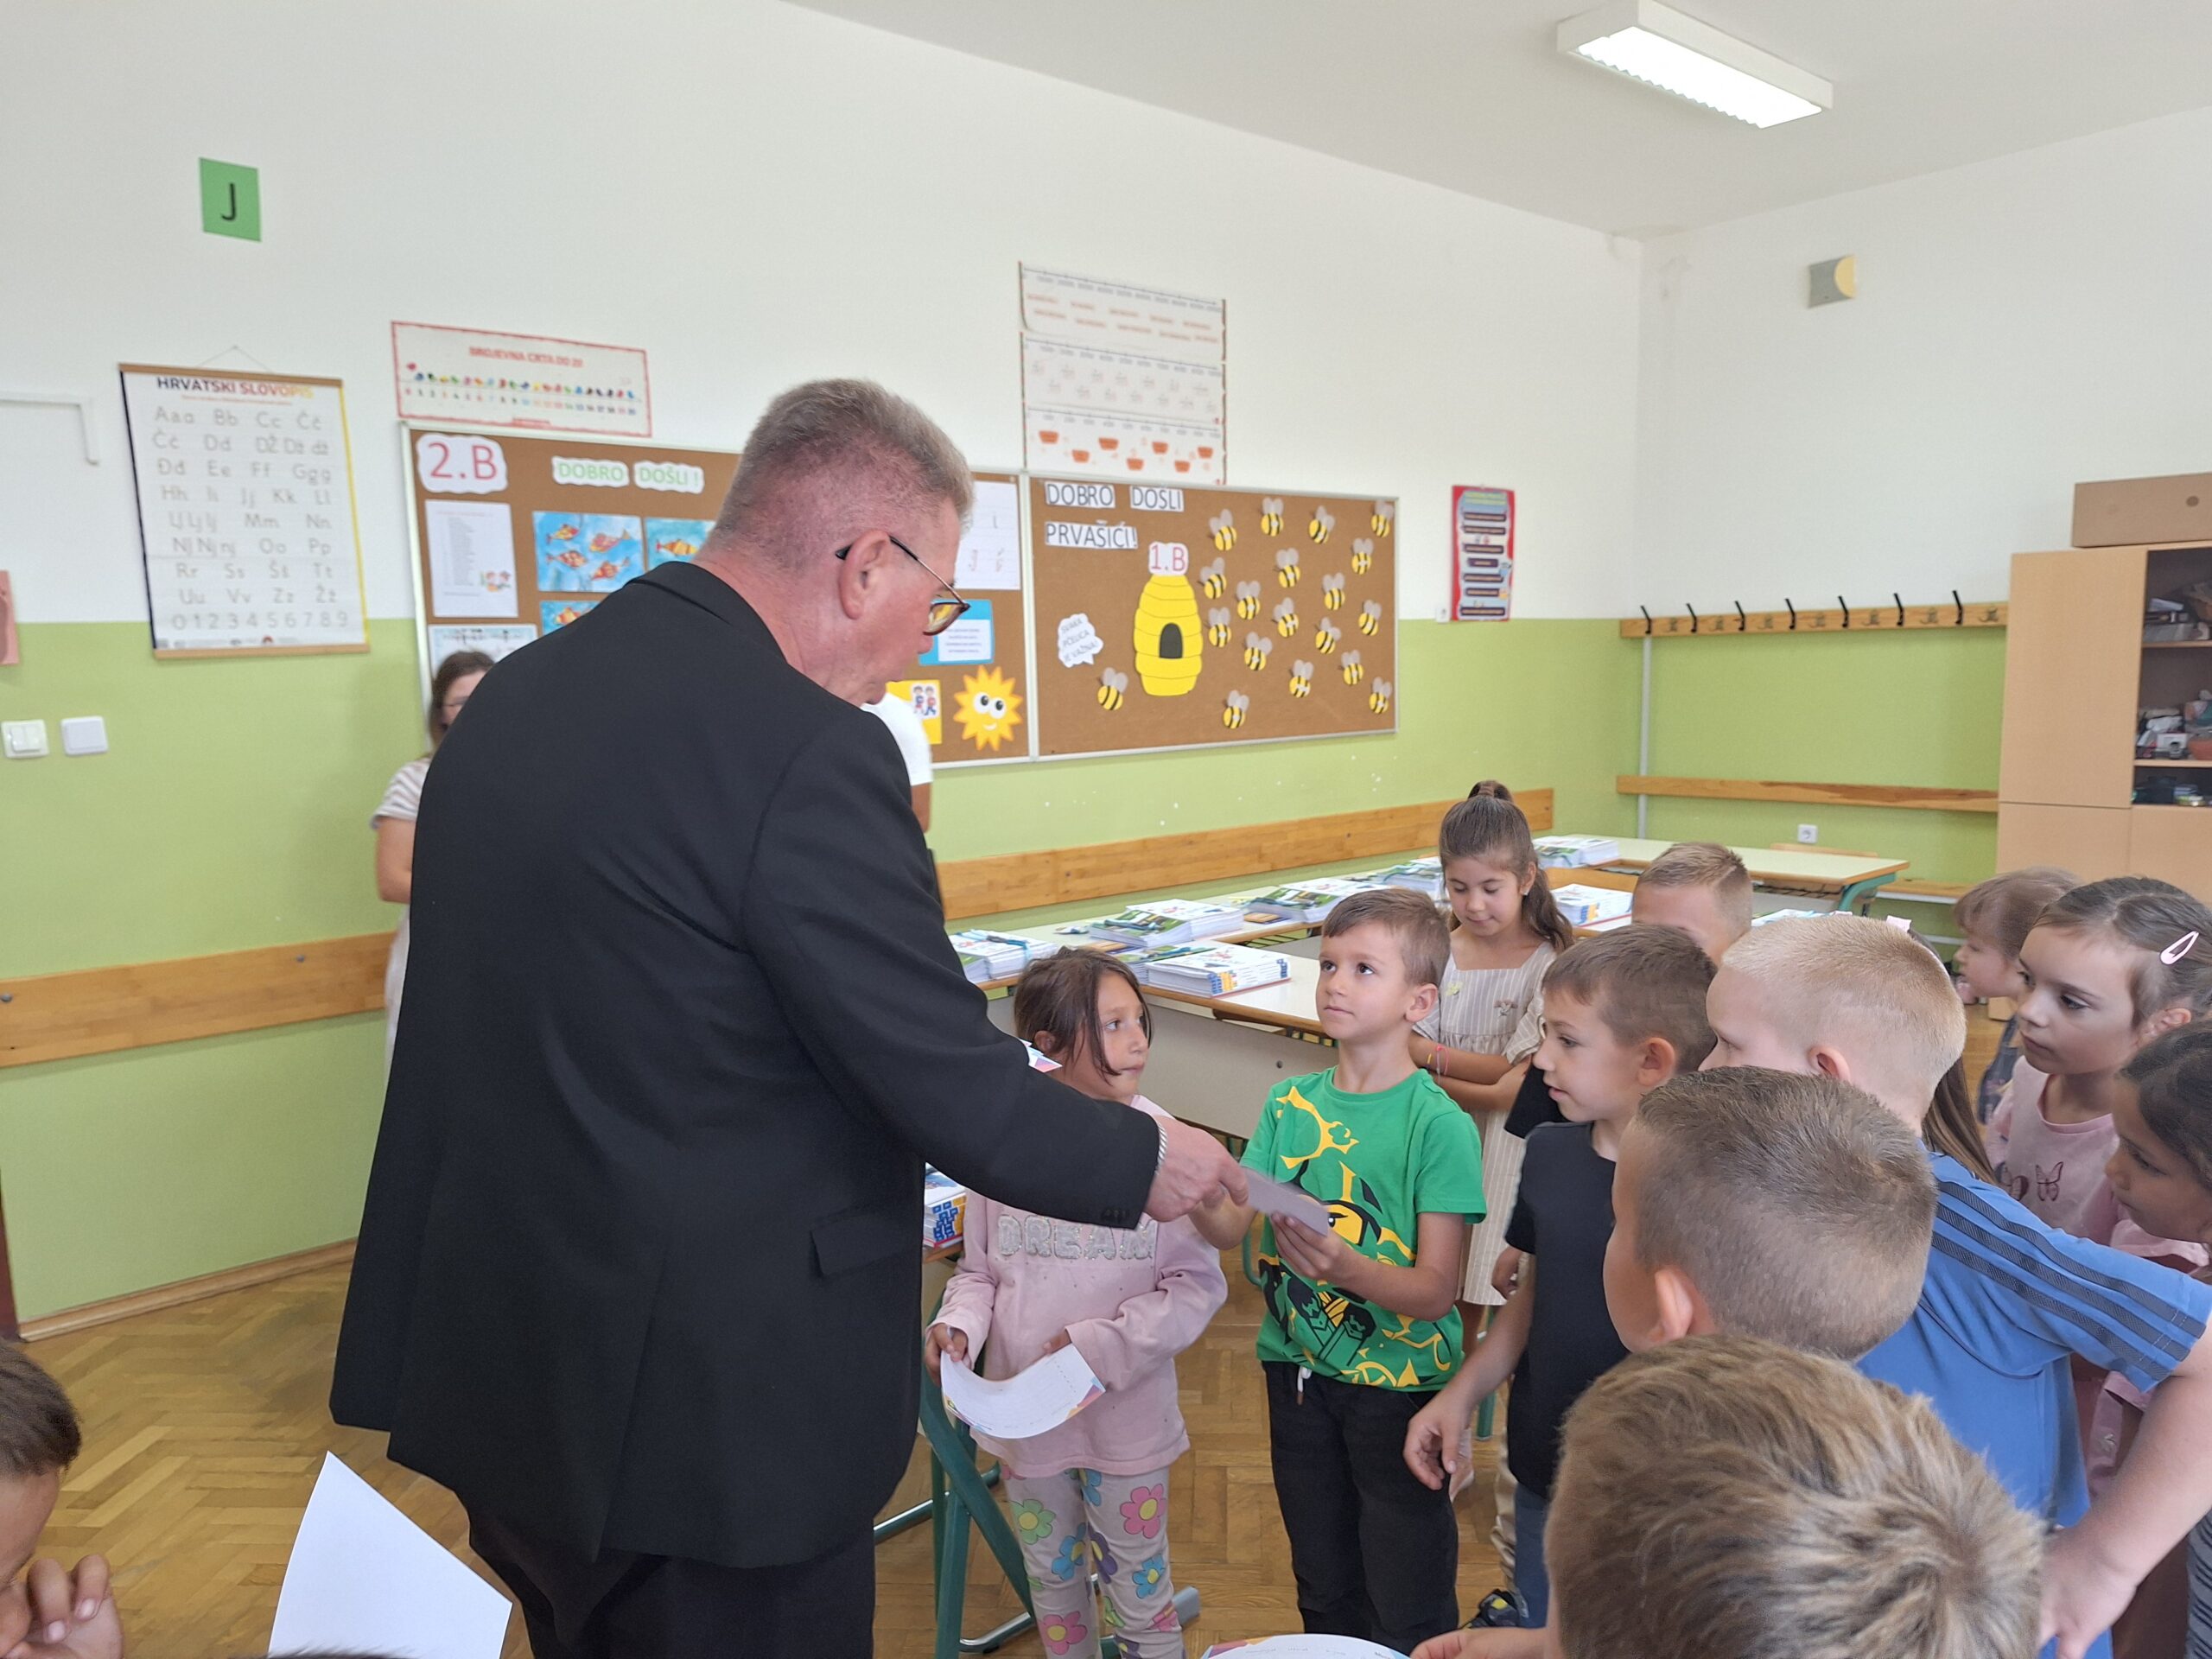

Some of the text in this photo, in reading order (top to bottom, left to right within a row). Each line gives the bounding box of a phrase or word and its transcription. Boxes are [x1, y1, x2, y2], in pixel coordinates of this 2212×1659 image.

[220, 182, 236, 220] J
[157, 376, 315, 399] HRVATSKI SLOVOPIS
[429, 442, 498, 480] 2.B
[558, 462, 624, 481] DOBRO
[1046, 483, 1114, 506] DOBRO
[1151, 544, 1186, 571] 1.B
[998, 1214, 1158, 1260] DREAM
